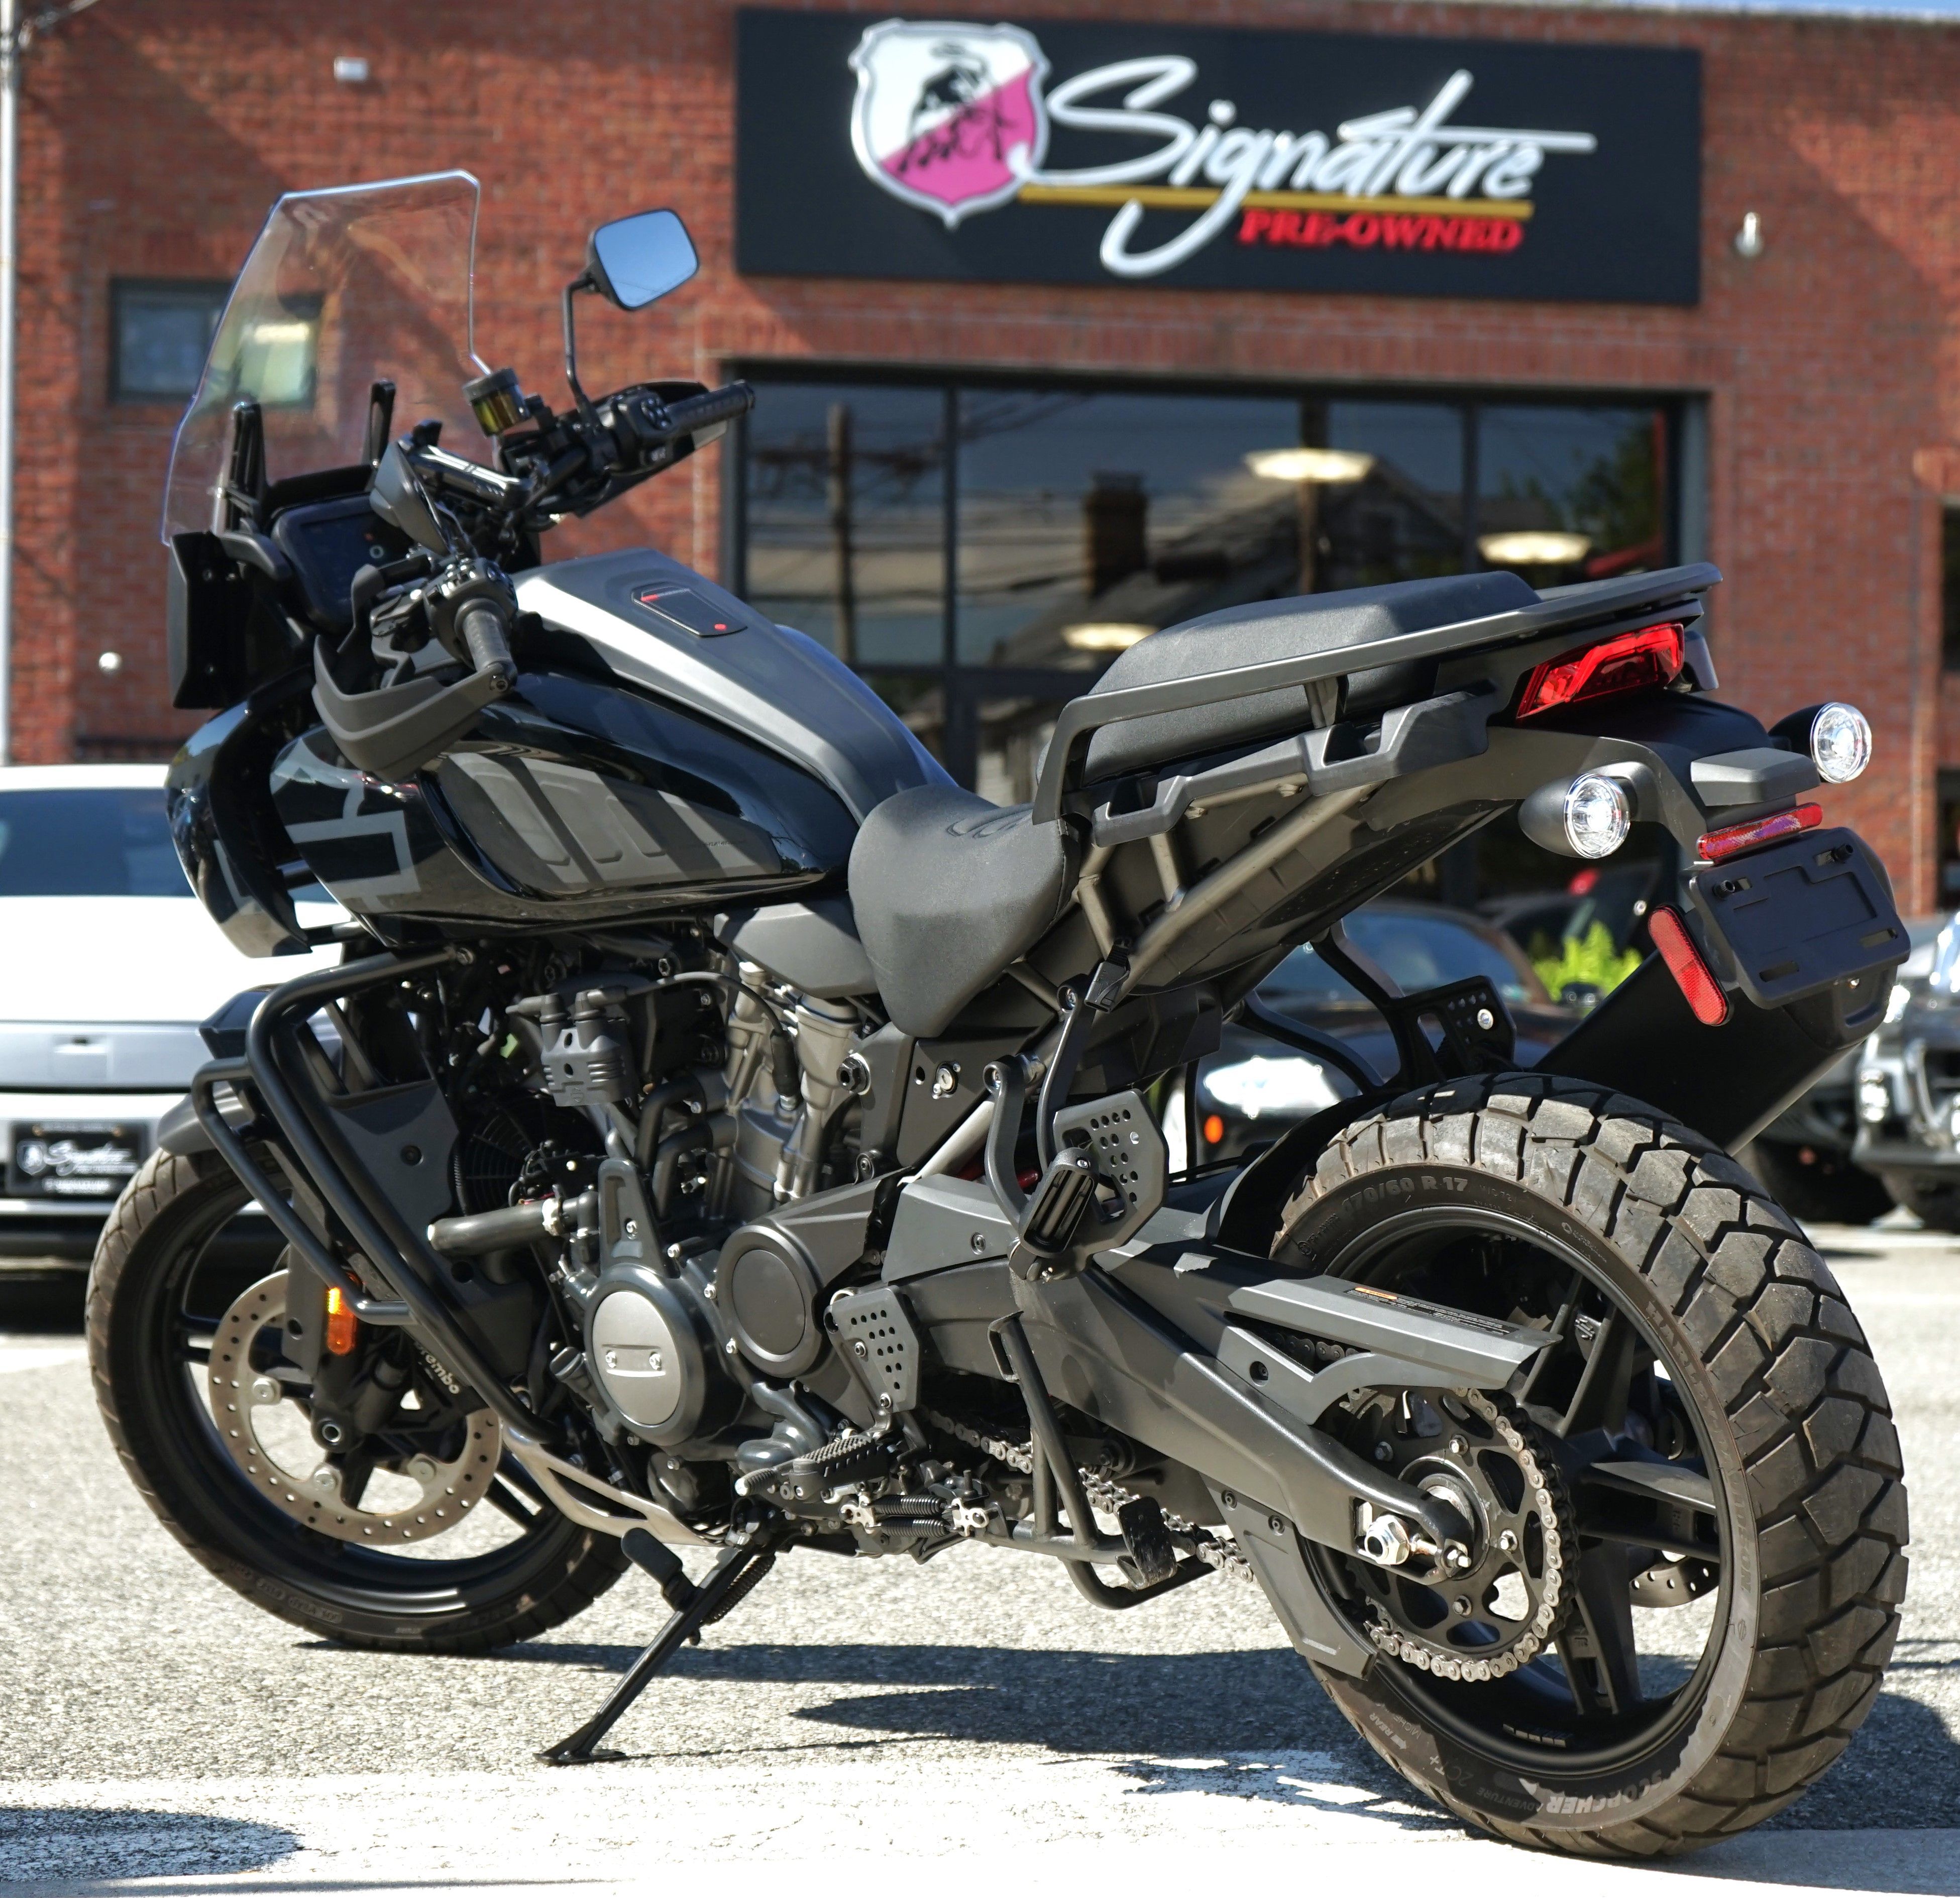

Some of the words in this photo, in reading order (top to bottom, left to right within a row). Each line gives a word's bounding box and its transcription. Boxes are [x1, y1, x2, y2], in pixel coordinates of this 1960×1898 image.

[1008, 55, 1596, 277] Signature
[1237, 208, 1524, 253] PRE-OWNED
[1342, 1177, 1415, 1212] 170/60
[1421, 1176, 1438, 1190] R
[1443, 1176, 1468, 1192] 17
[1369, 1712, 1394, 1737] REAR
[1546, 1769, 1662, 1814] SCORCHER
